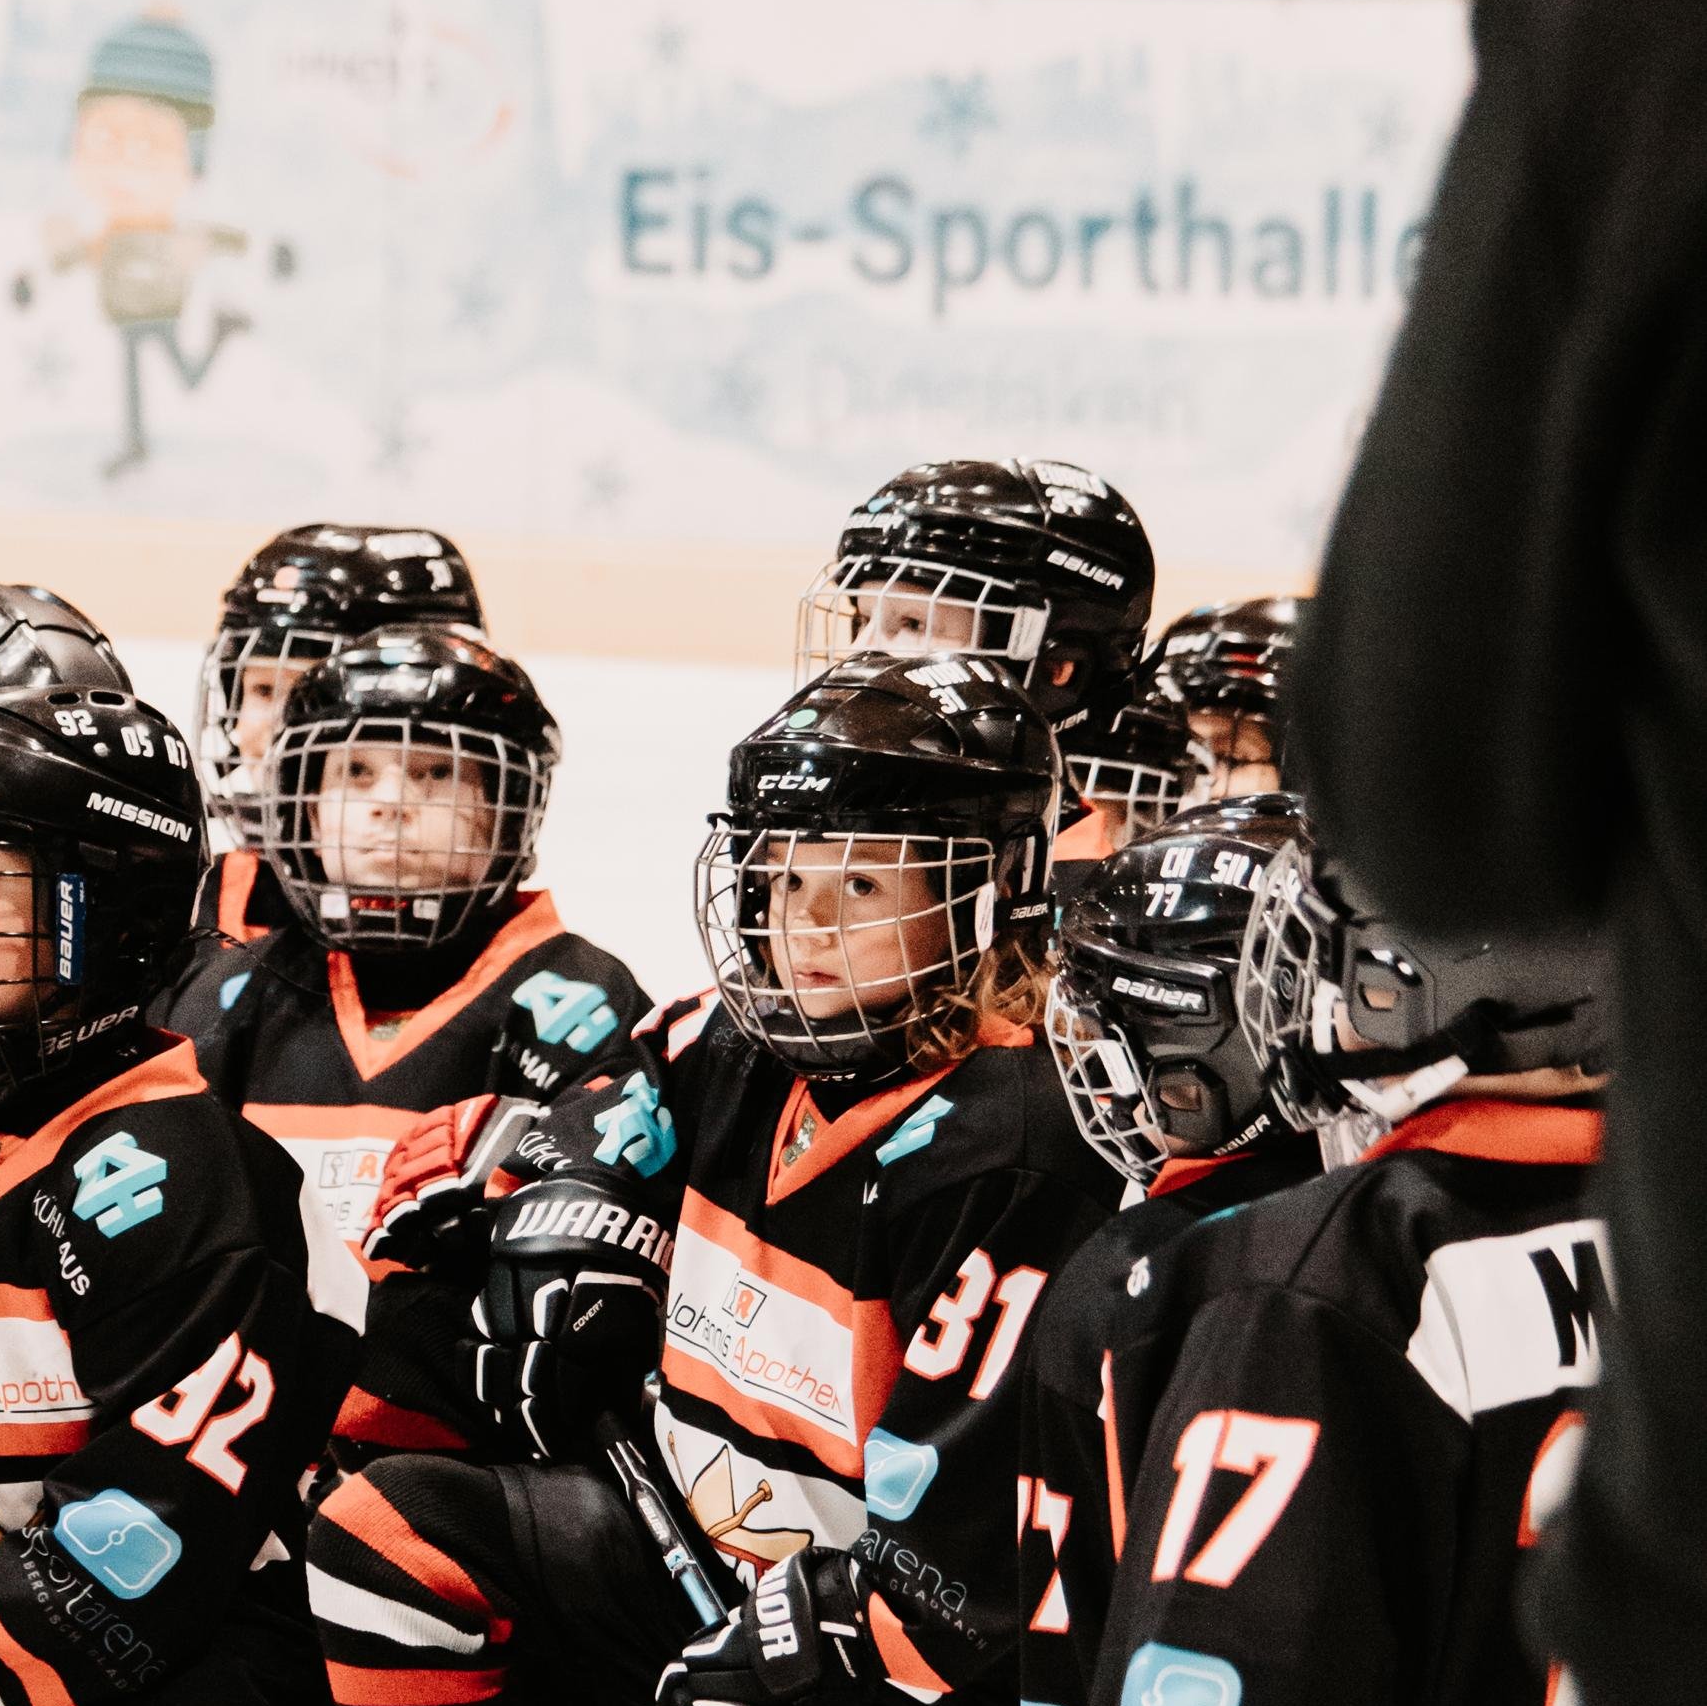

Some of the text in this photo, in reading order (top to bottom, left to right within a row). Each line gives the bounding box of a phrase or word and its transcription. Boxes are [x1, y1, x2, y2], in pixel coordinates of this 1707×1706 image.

[54, 708, 99, 737] 92
[756, 774, 832, 792] CCM
[85, 792, 194, 843] MISSION
[59, 880, 75, 980] BAUER
[1111, 975, 1204, 1010] BAUER
[1213, 1112, 1271, 1157] BAUER
[572, 1299, 604, 1332] COVERT
[904, 1247, 1048, 1400] 31
[1150, 1408, 1322, 1590] 17
